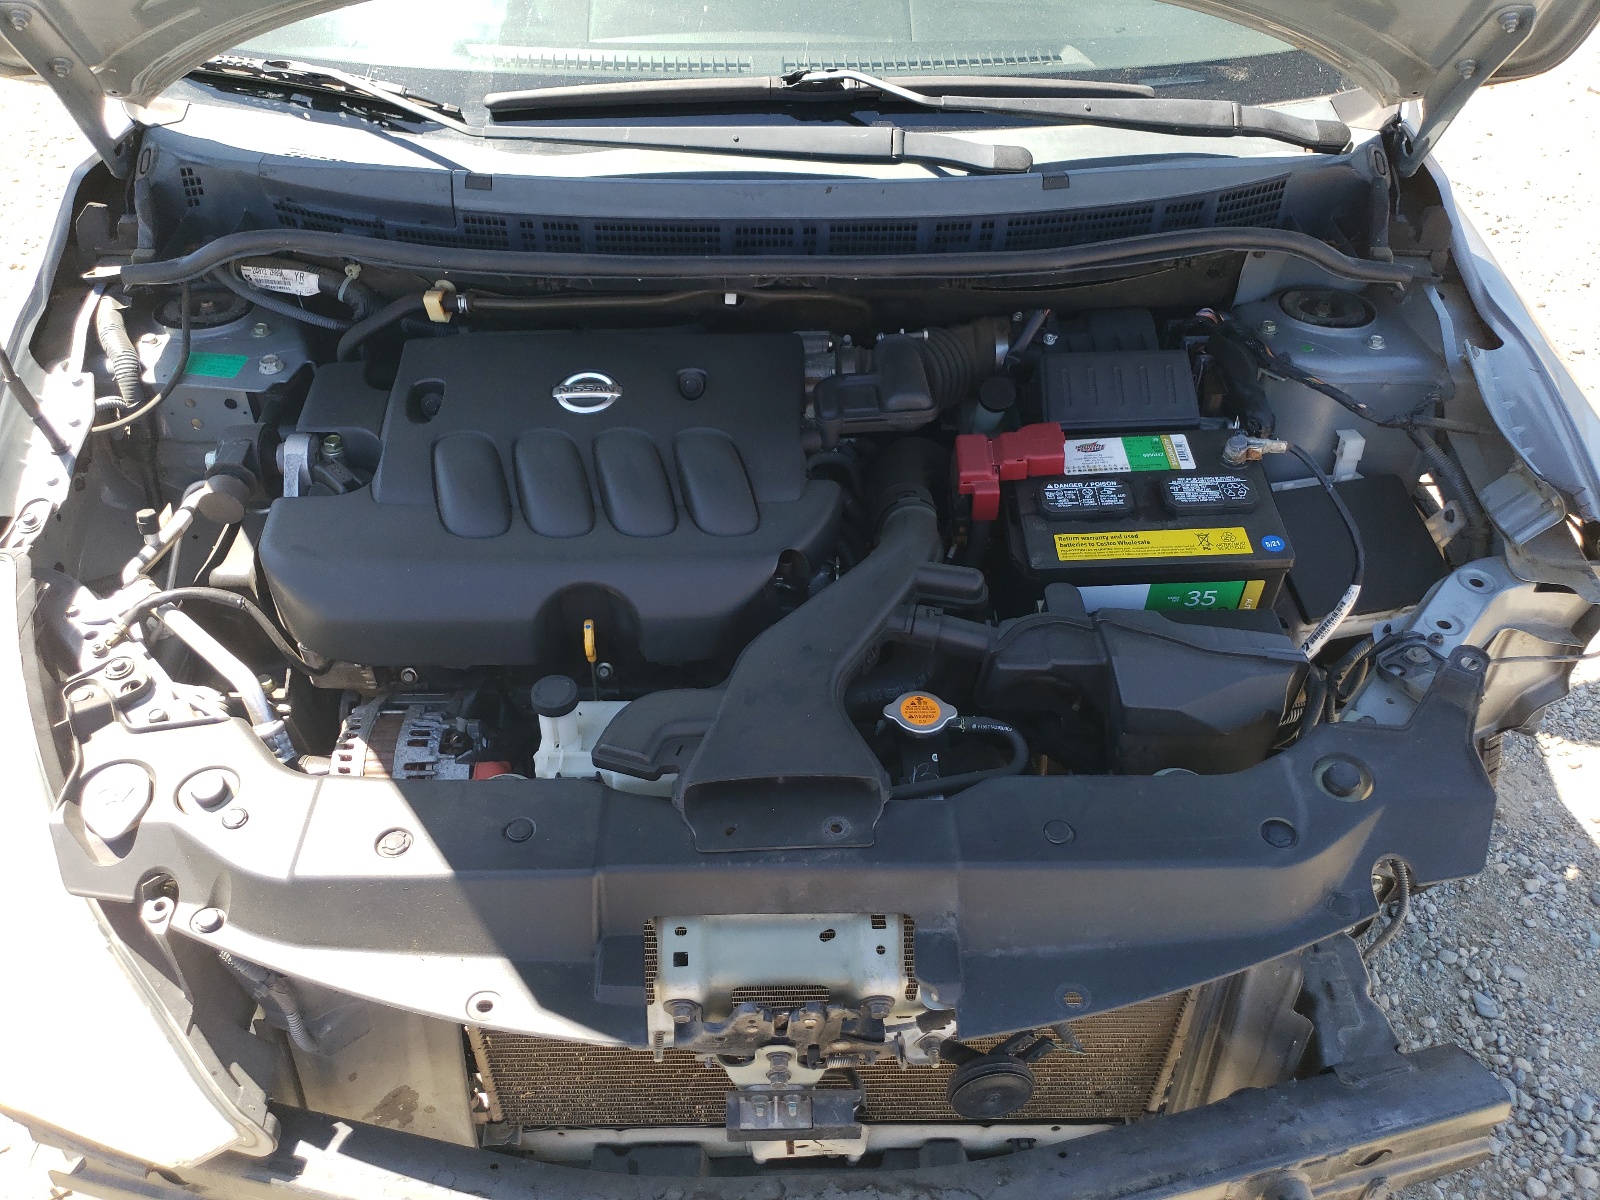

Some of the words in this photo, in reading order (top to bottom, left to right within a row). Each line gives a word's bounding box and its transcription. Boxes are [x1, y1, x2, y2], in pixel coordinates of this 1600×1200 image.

[294, 271, 305, 282] YR
[559, 384, 616, 393] NISSAN
[1183, 590, 1218, 607] 35
